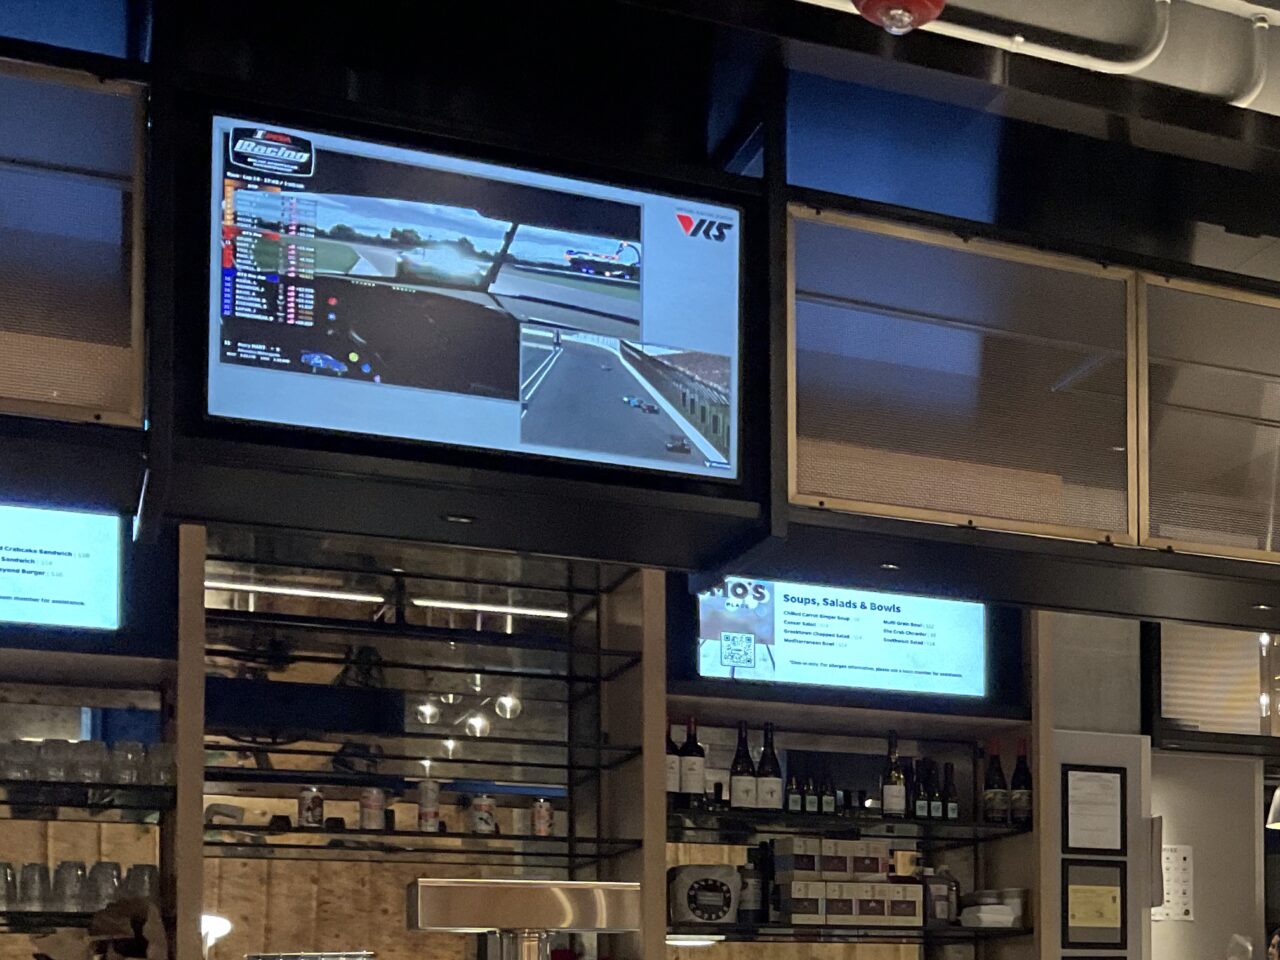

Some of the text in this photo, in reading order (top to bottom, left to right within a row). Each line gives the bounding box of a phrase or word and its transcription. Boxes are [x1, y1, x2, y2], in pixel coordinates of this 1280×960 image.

[39, 549, 72, 557] Sandwich
[1, 556, 35, 564] Sandwich
[783, 594, 901, 613] Soups, Salads & Bowls
